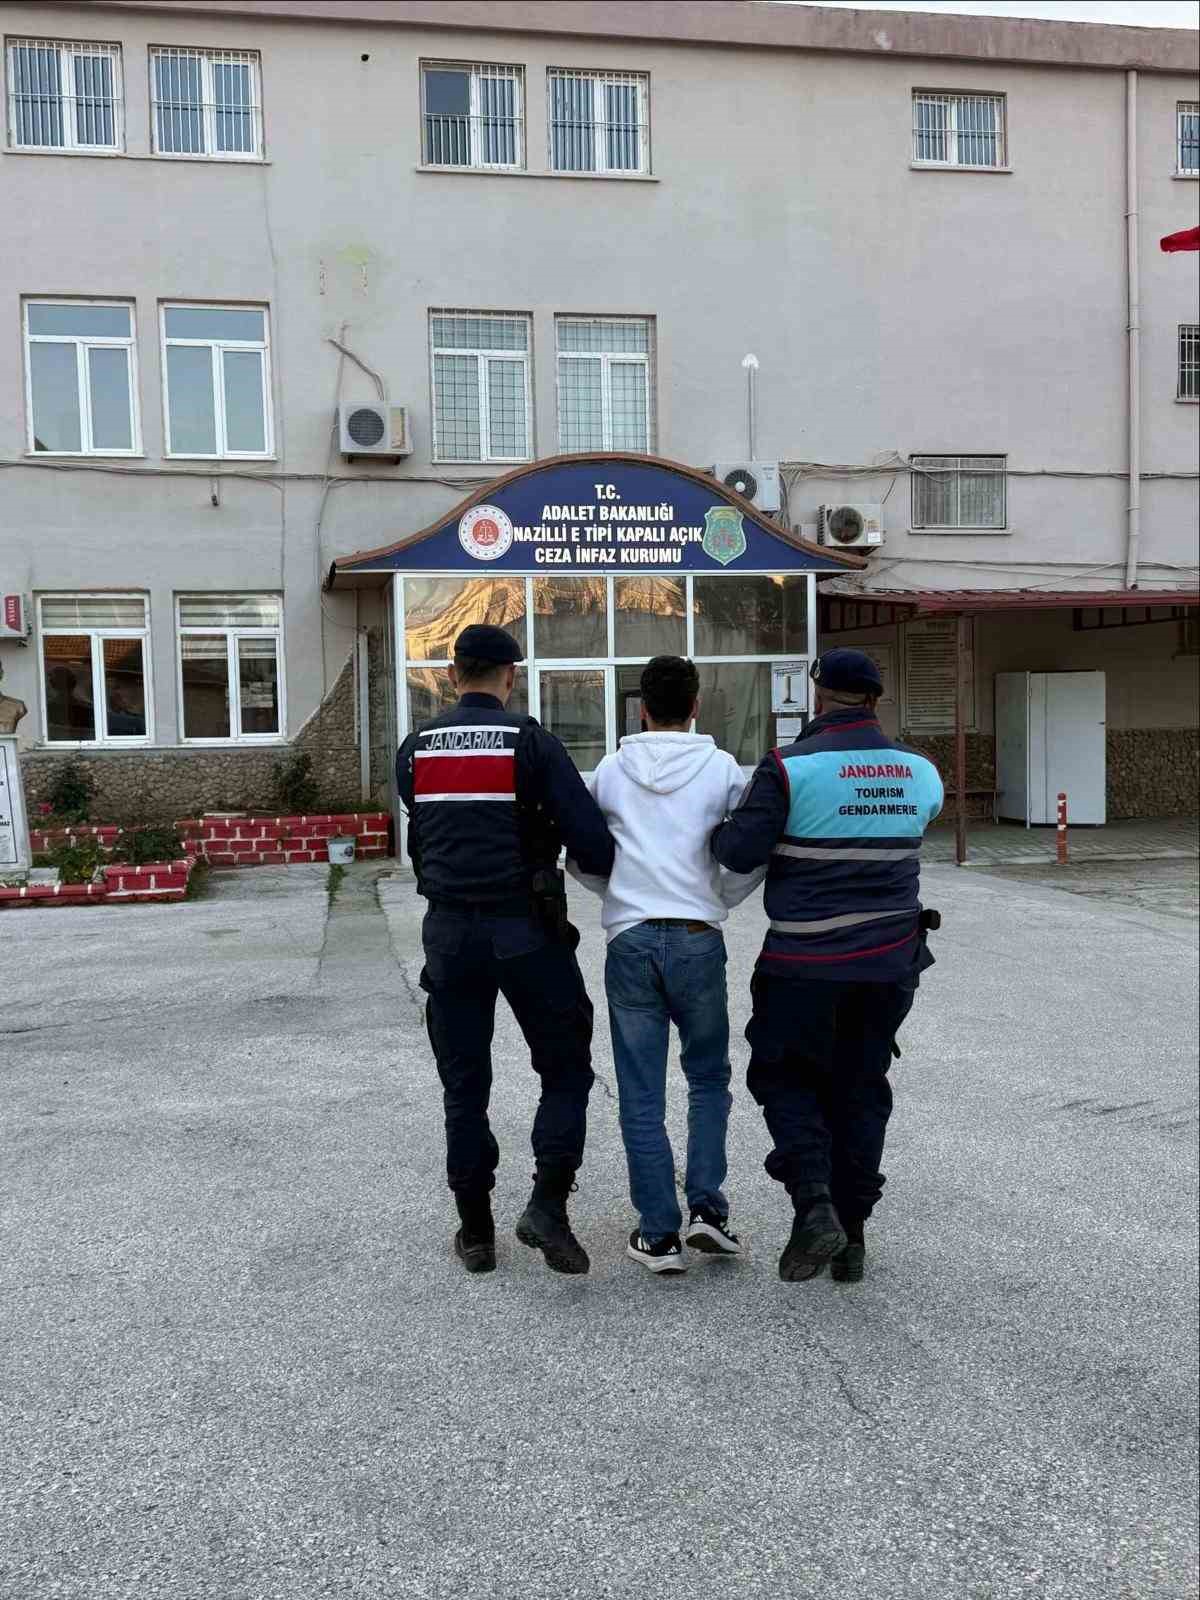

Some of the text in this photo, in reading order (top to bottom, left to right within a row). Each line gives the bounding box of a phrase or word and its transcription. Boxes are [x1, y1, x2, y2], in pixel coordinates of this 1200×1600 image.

[594, 484, 621, 500] T.C.
[542, 502, 674, 521] ADALET BAKANLIĞI
[513, 523, 703, 546] NAZİLLİ E TİPİ KAPALI AÇIK
[535, 545, 682, 563] CEZA İNFAZ KURUMU
[425, 731, 505, 750] JANDARMA
[839, 764, 913, 779] JANDARMA
[855, 787, 905, 799] TOURISM
[838, 804, 918, 816] GENDARMERIE
